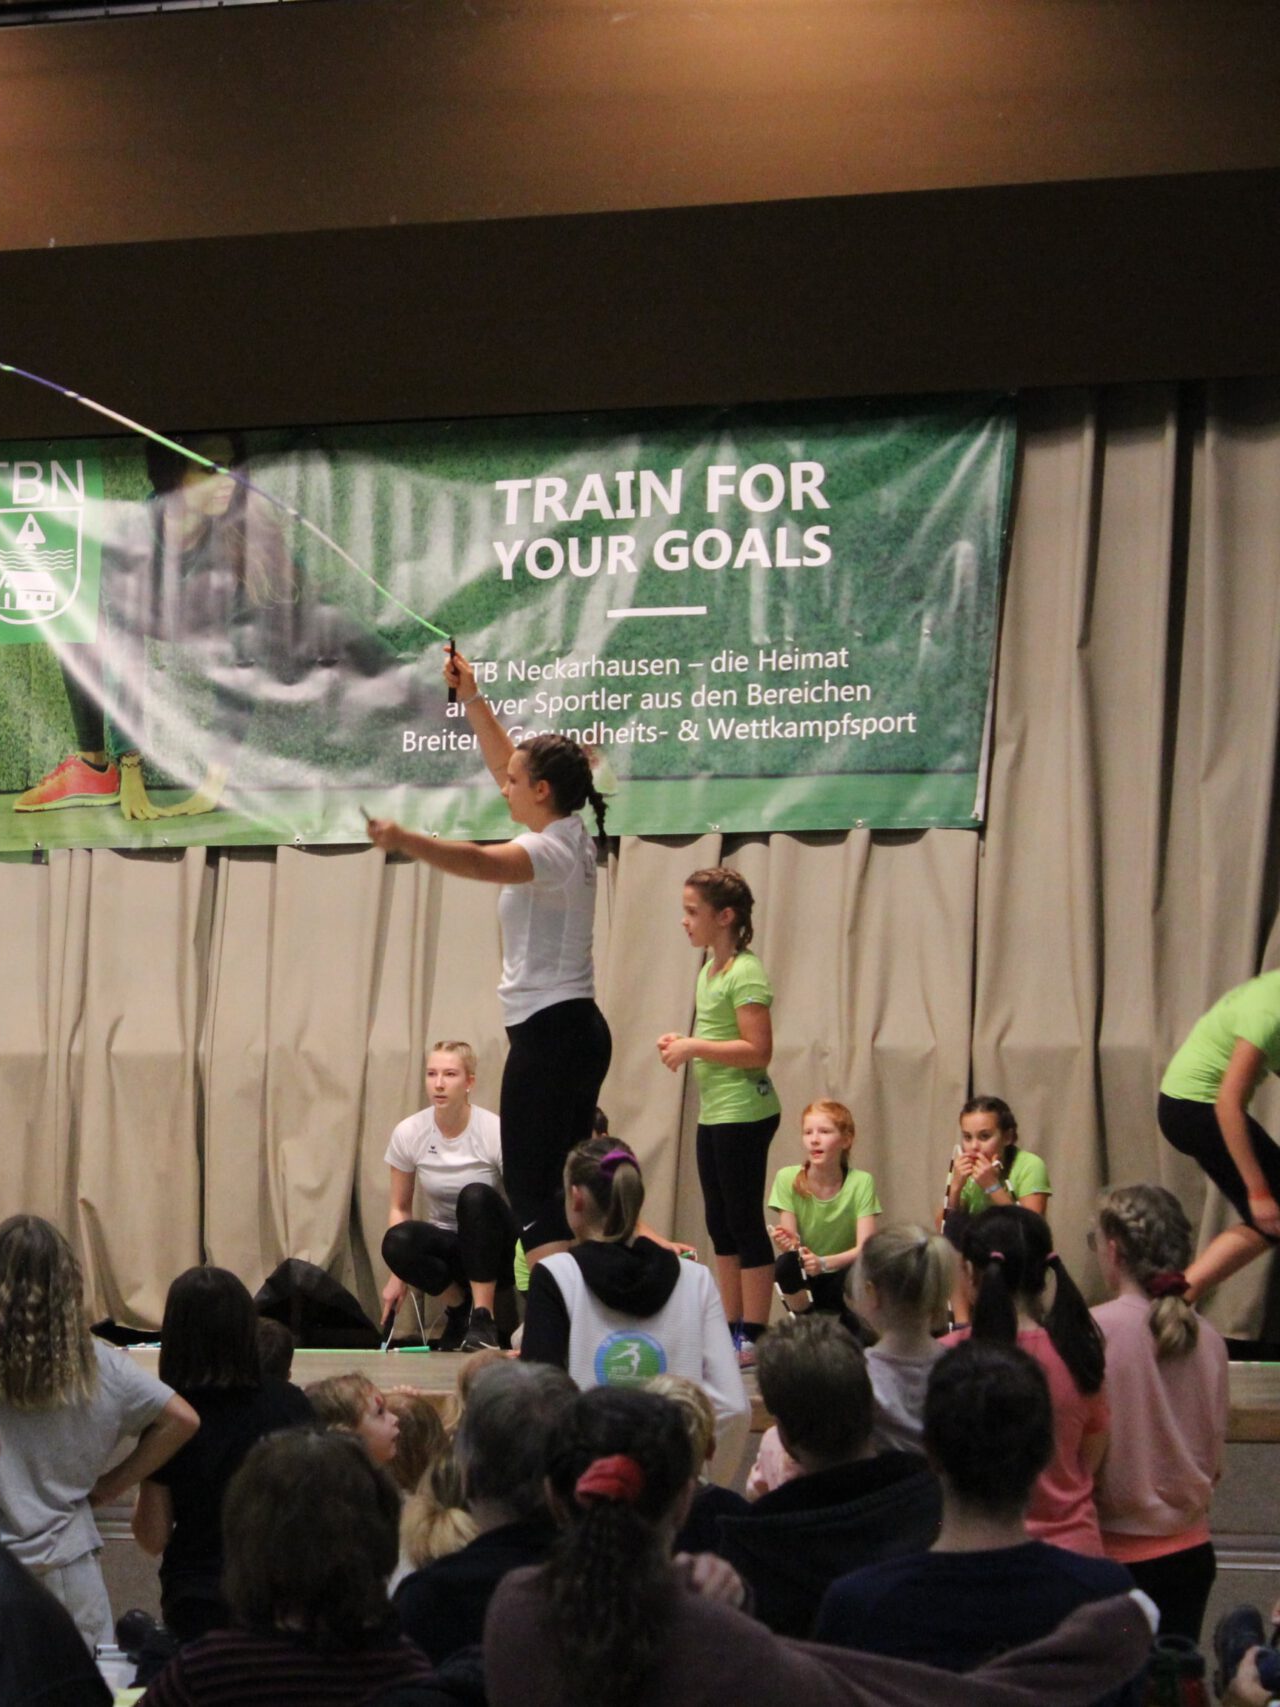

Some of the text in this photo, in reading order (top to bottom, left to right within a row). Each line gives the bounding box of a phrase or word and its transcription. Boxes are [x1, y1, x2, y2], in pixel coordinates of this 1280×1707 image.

[495, 461, 830, 525] TRAIN FOR
[493, 525, 832, 580] YOUR GOALS
[471, 661, 498, 683] TB
[507, 654, 680, 682] Neckarhausen
[710, 650, 749, 673] die
[758, 648, 849, 672] Heimat
[534, 688, 632, 718] Sportler
[639, 691, 682, 710] aus
[690, 684, 737, 708] den
[747, 680, 871, 706] Bereichen
[677, 719, 700, 741] &
[708, 712, 917, 743] Wettkampfsport
